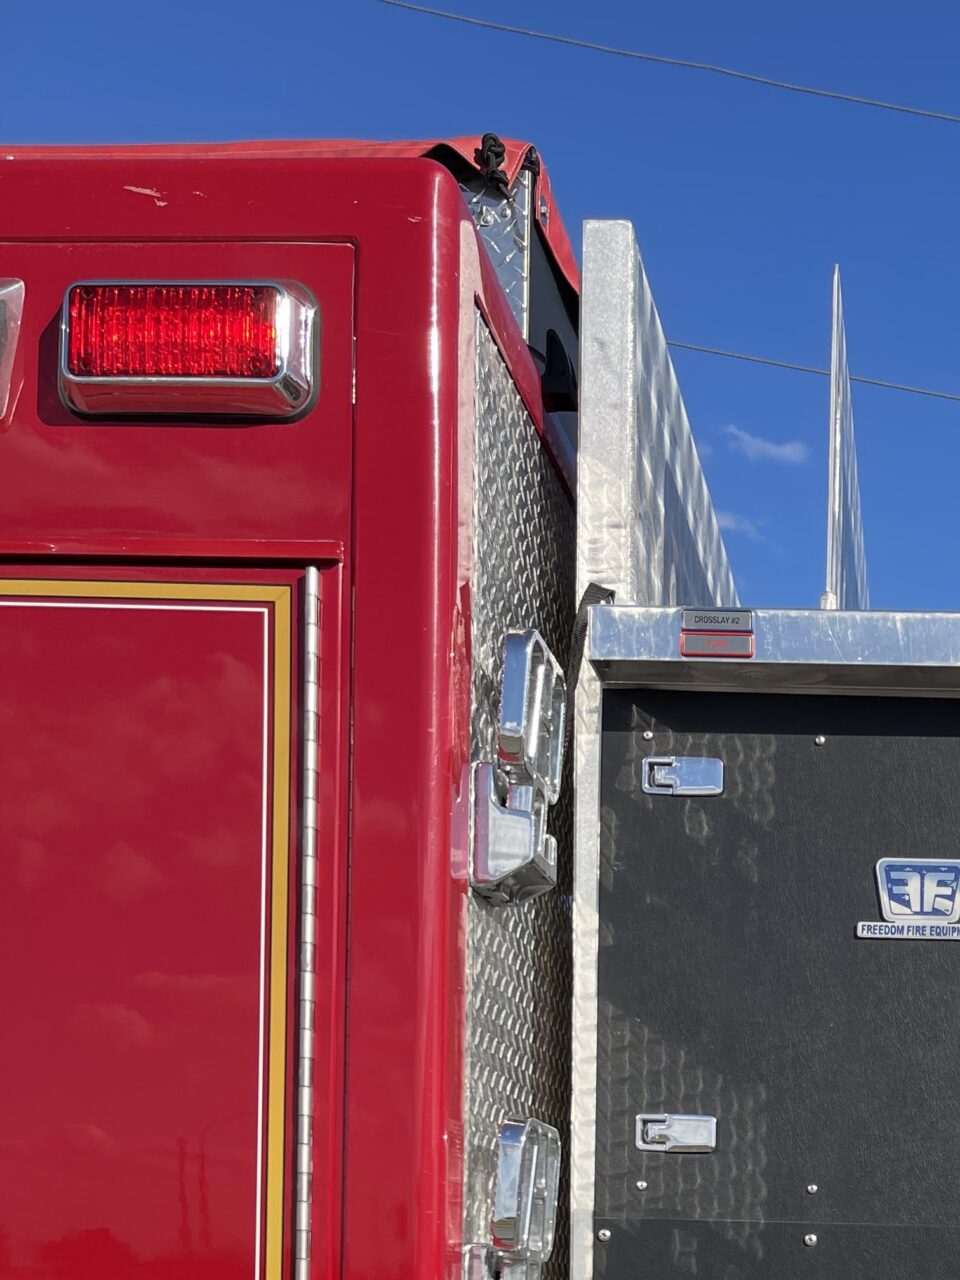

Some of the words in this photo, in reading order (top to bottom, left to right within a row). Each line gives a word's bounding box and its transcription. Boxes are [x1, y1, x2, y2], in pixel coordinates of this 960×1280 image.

[694, 615, 730, 624] CROSSLAY
[731, 616, 740, 624] #2
[861, 924, 904, 935] FREEDOM
[906, 925, 927, 936] FIRE
